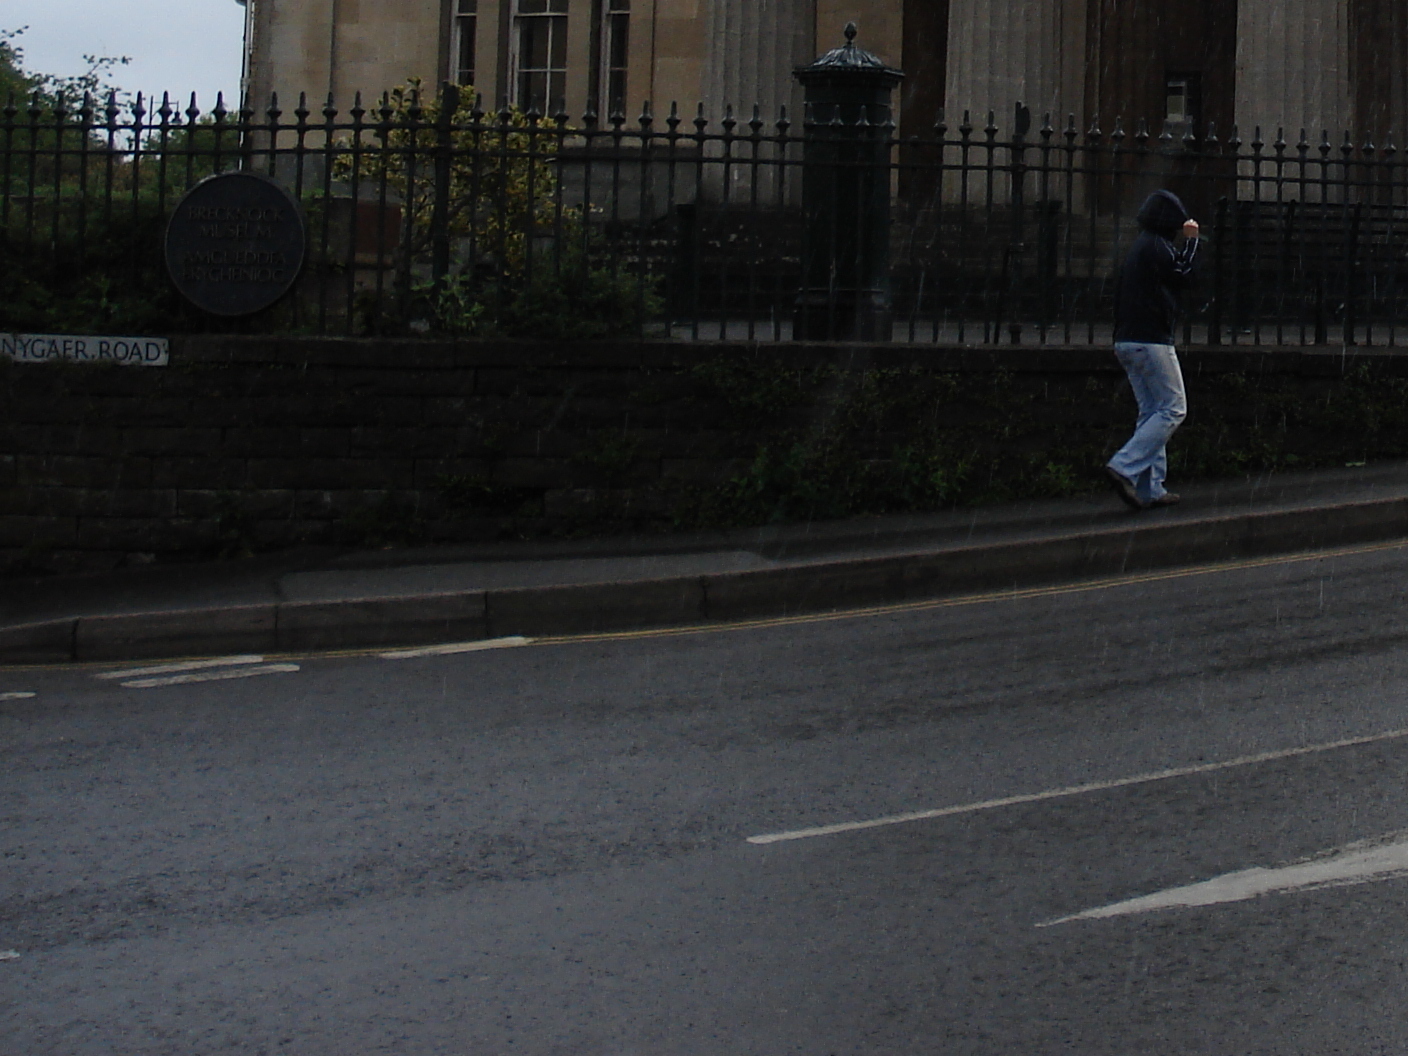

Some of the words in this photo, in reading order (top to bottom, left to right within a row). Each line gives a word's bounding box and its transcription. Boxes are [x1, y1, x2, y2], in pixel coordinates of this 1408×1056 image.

[188, 205, 284, 221] BRECKNOCK
[200, 223, 272, 238] MUSEUM
[98, 341, 161, 361] ROAD
